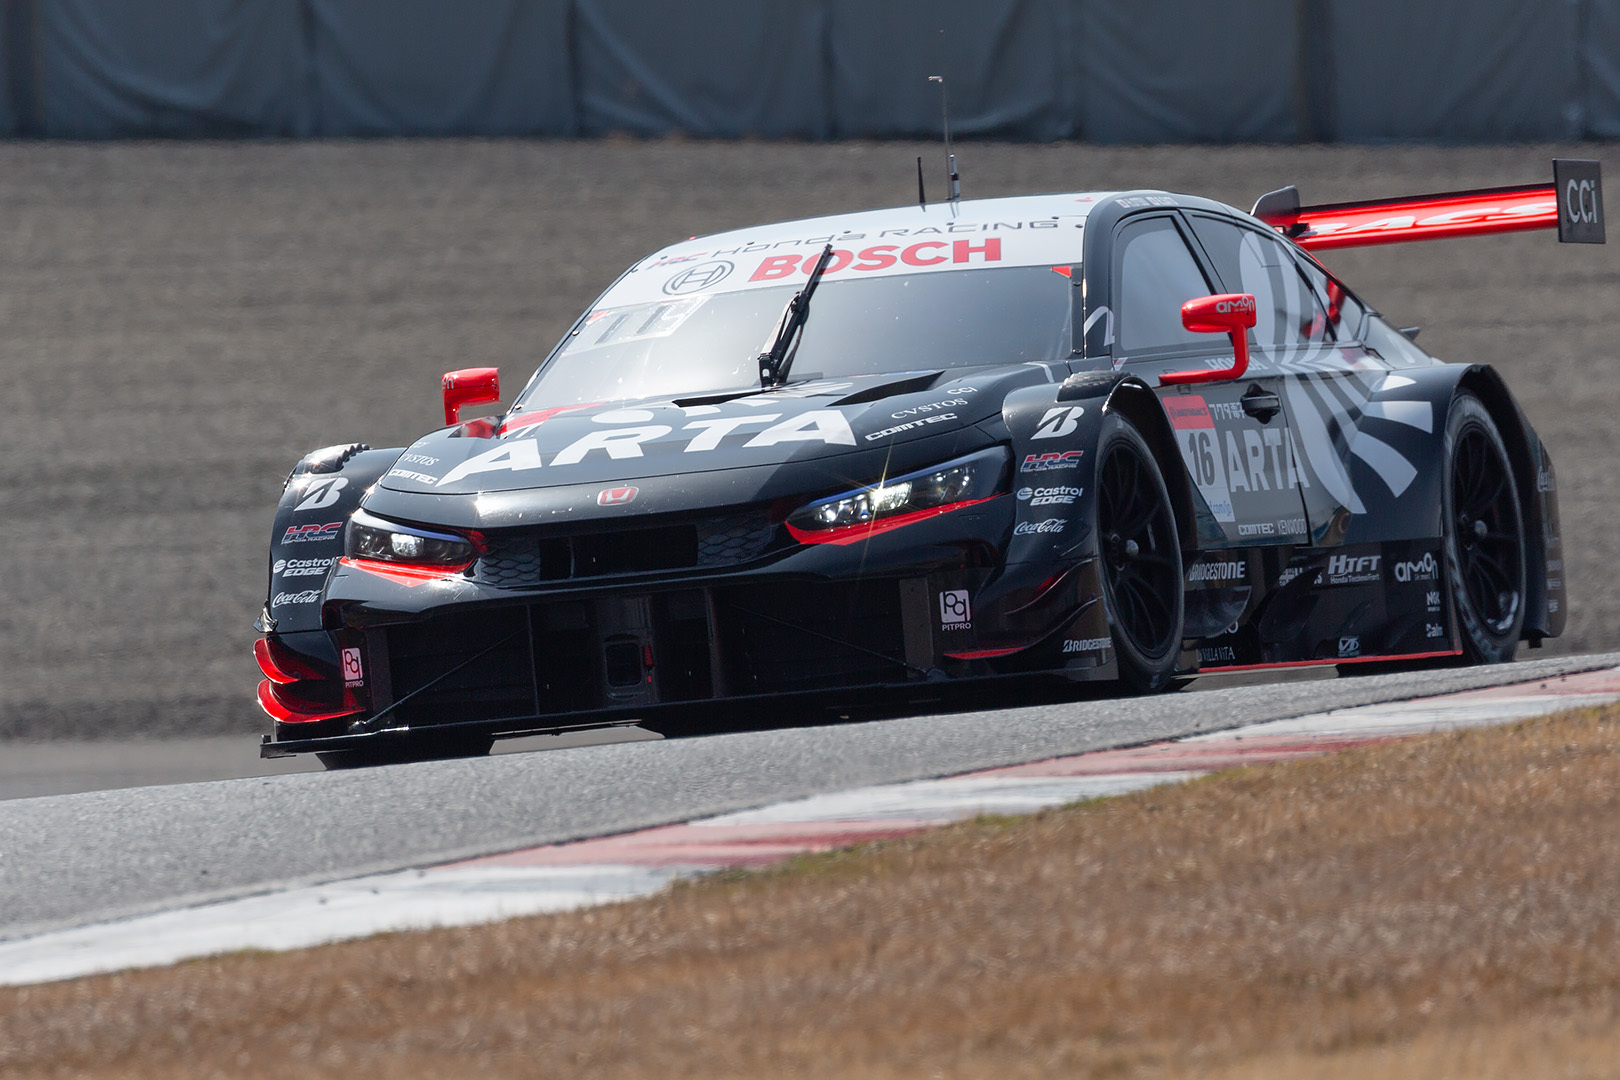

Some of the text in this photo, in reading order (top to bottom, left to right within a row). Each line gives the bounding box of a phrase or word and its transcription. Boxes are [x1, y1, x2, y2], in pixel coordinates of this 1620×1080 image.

[879, 219, 1059, 238] RACING
[747, 237, 1002, 283] BOSCH
[864, 412, 959, 441] COMTEC
[435, 409, 858, 488] ARTA
[1020, 450, 1084, 470] HRC
[1188, 431, 1216, 487] 16
[1225, 427, 1311, 494] ARTA
[388, 468, 438, 485] COMTEC
[1034, 485, 1084, 498] Castrol
[1030, 495, 1077, 507] EDGE
[281, 521, 344, 543] HRC
[1238, 522, 1275, 536] COMTEC
[1276, 518, 1308, 536] KENWOOD
[286, 557, 335, 568] Castrol
[1188, 561, 1246, 582] BRIDGESTONE
[282, 566, 328, 578] EDGE
[941, 622, 972, 632] PITPRO
[1062, 636, 1112, 653] BRIDGESTONE
